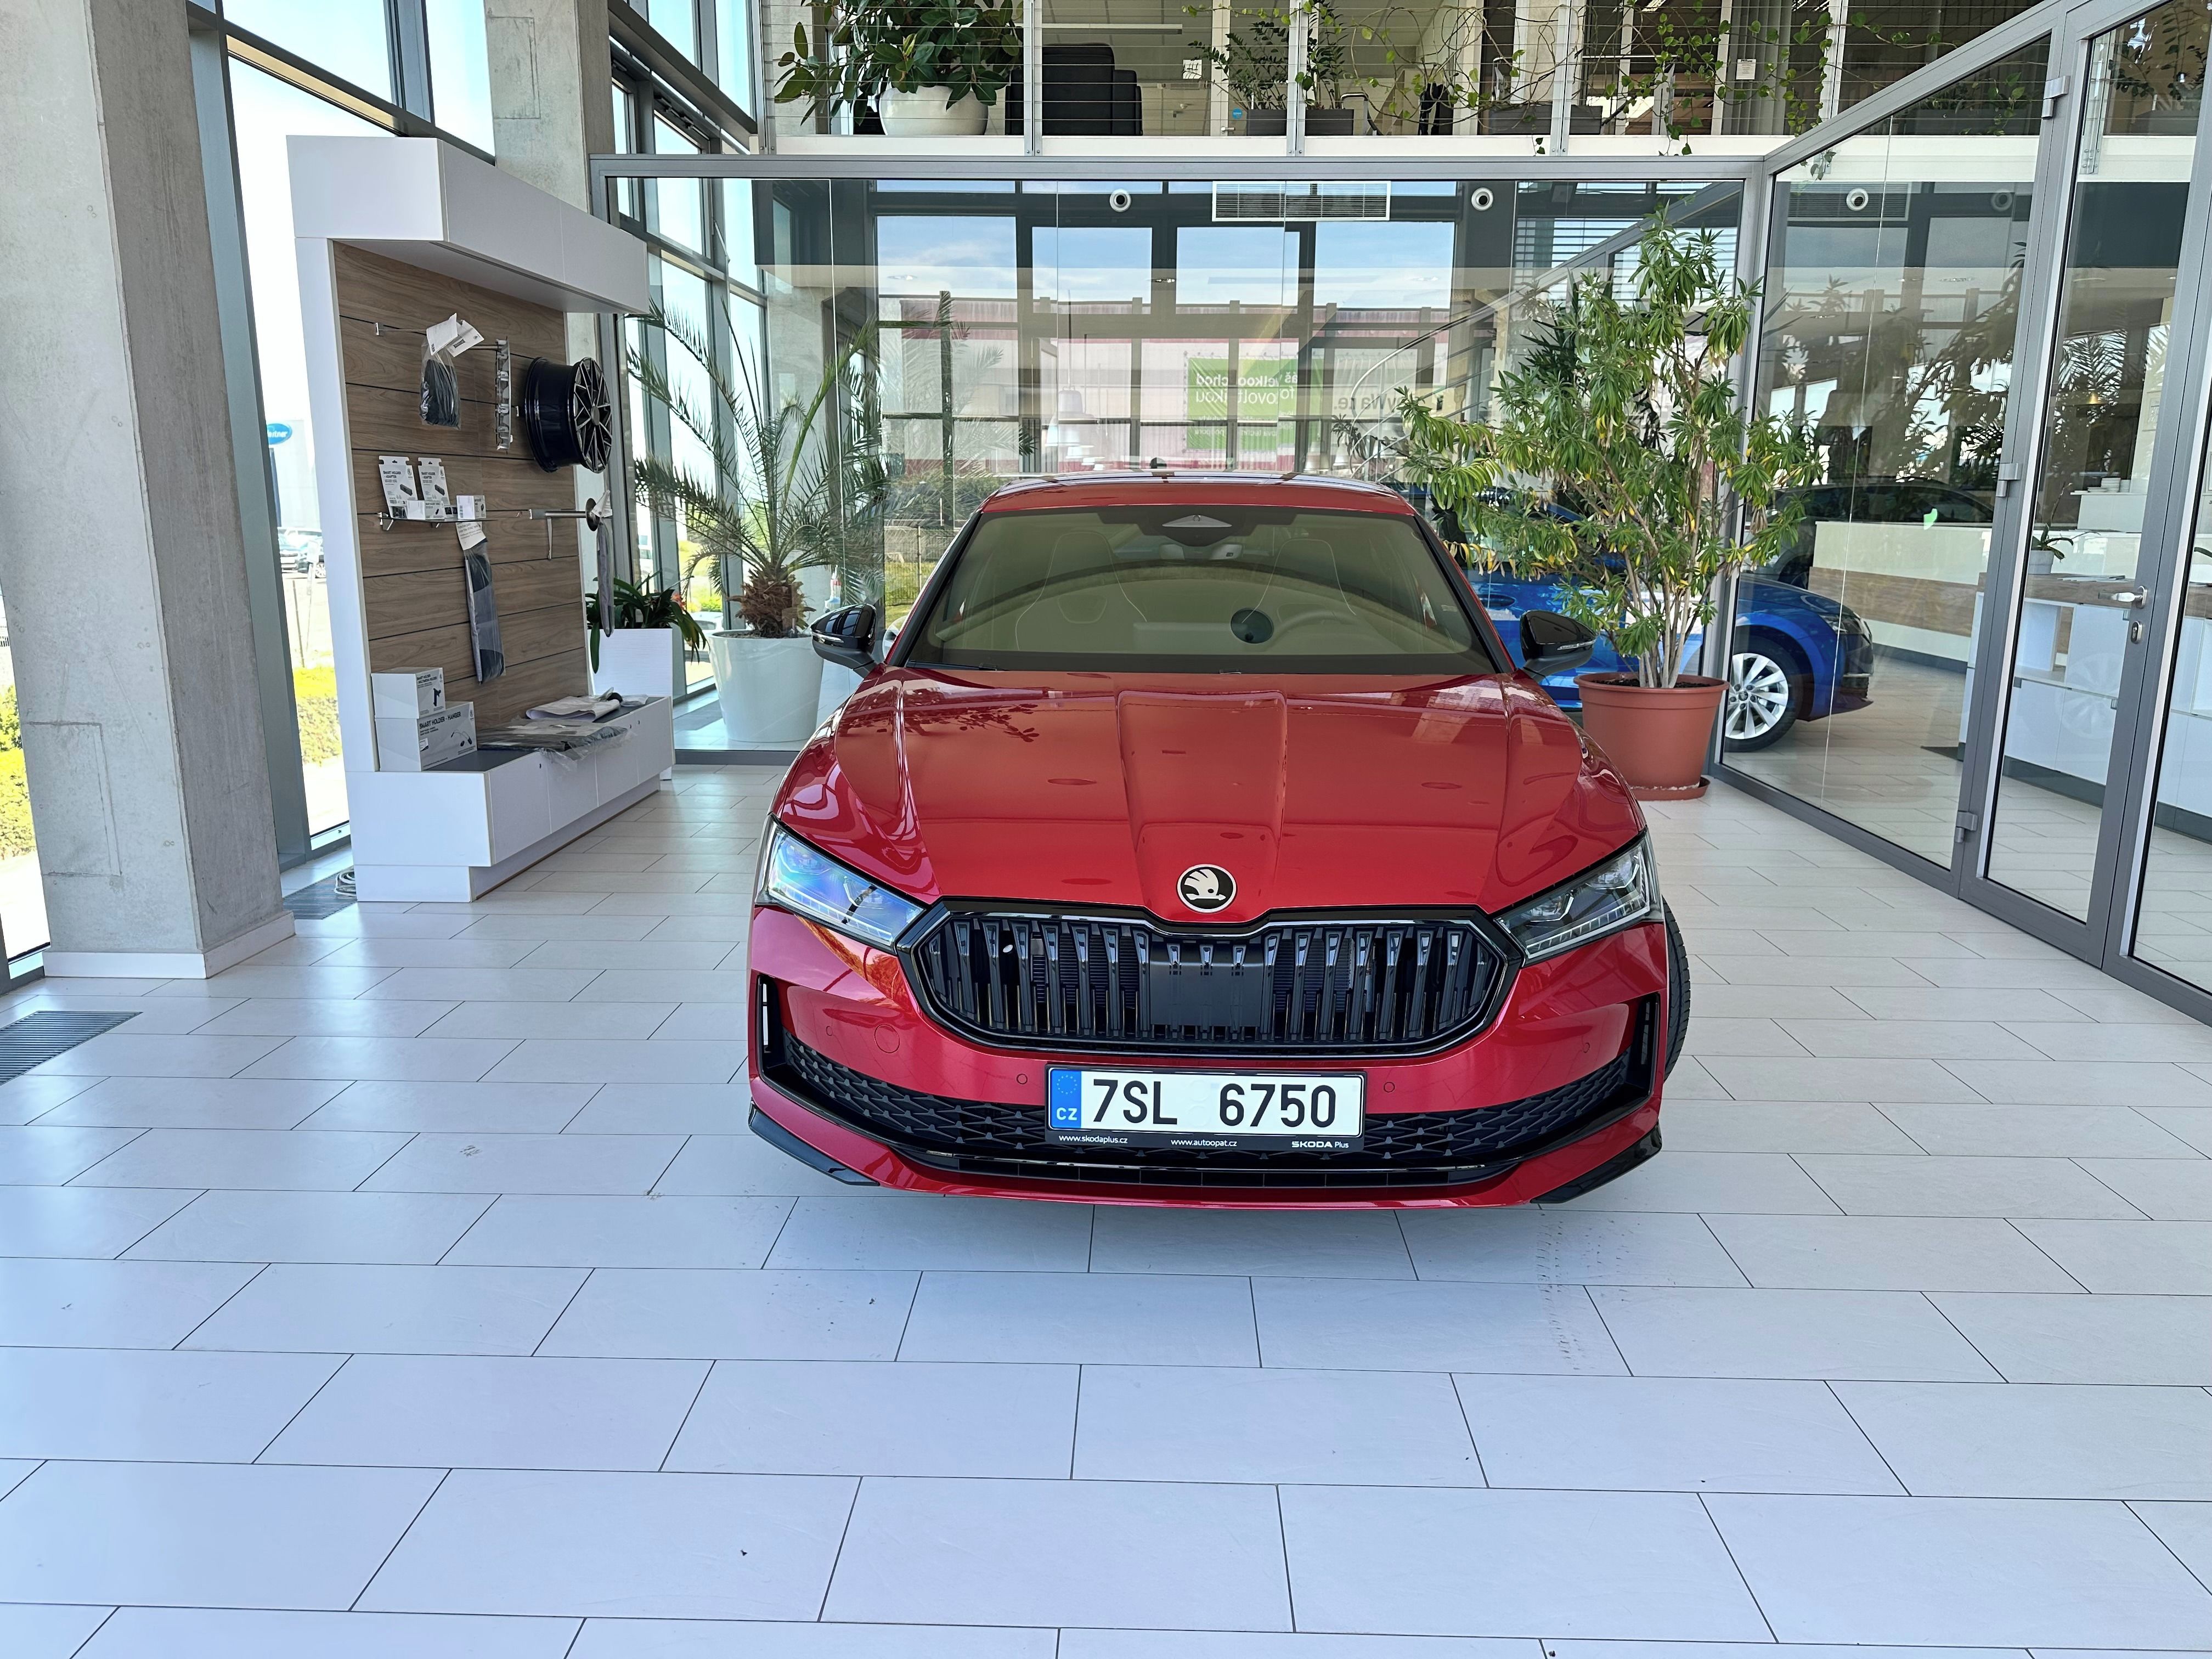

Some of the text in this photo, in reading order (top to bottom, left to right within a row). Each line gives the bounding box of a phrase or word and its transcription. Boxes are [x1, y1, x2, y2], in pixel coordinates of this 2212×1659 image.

[420, 720, 431, 729] SMART
[431, 716, 445, 725] HOLDER
[447, 712, 461, 720] HANGER
[1093, 1079, 1336, 1128] 7SL 6750
[1056, 1107, 1077, 1121] CZ
[1059, 1135, 1128, 1144] www.skodaplus.cz
[1171, 1139, 1238, 1147] www.autoopat.cz
